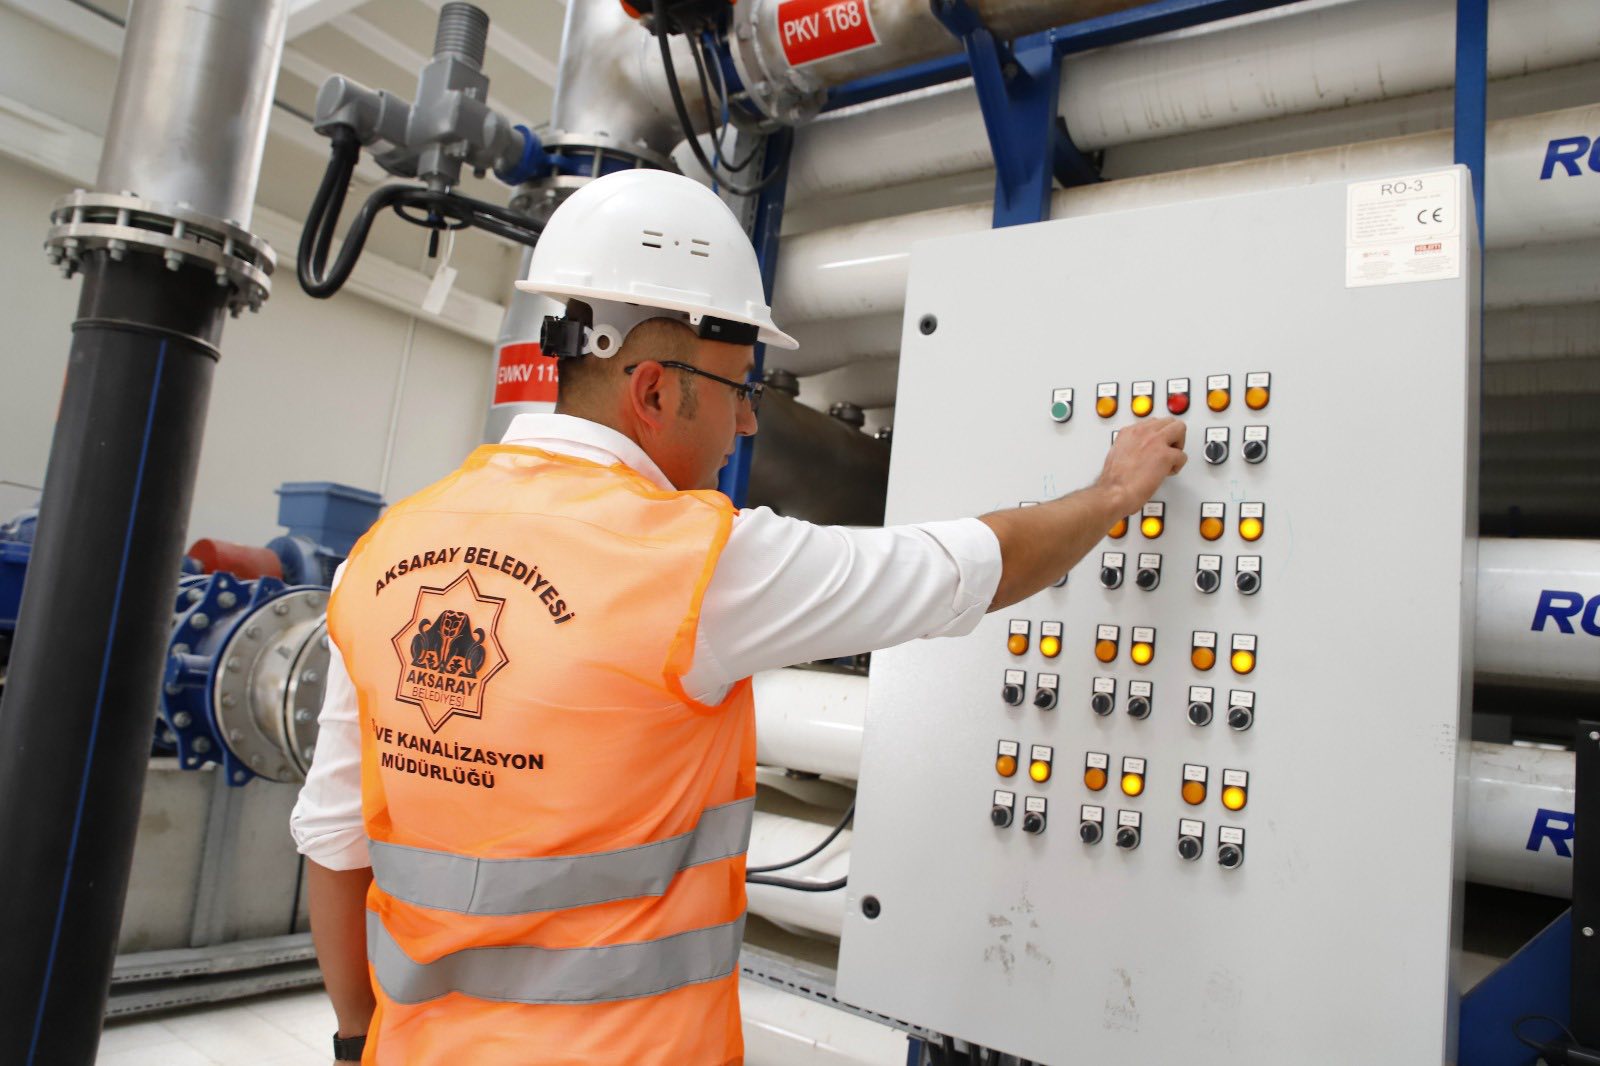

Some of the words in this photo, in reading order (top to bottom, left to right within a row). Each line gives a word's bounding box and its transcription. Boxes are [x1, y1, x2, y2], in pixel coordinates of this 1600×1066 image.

[783, 12, 819, 46] PKV
[1381, 179, 1424, 196] RO-3
[375, 546, 461, 597] AKSARAY
[463, 546, 576, 625] BELEDİYESİ
[406, 669, 478, 697] AKSARAY
[411, 686, 465, 708] BELEDİYESİ
[375, 727, 393, 744] VE
[397, 731, 544, 770] KANALİZASYON
[381, 752, 495, 789] MÜDÜRLÜĞÜ
